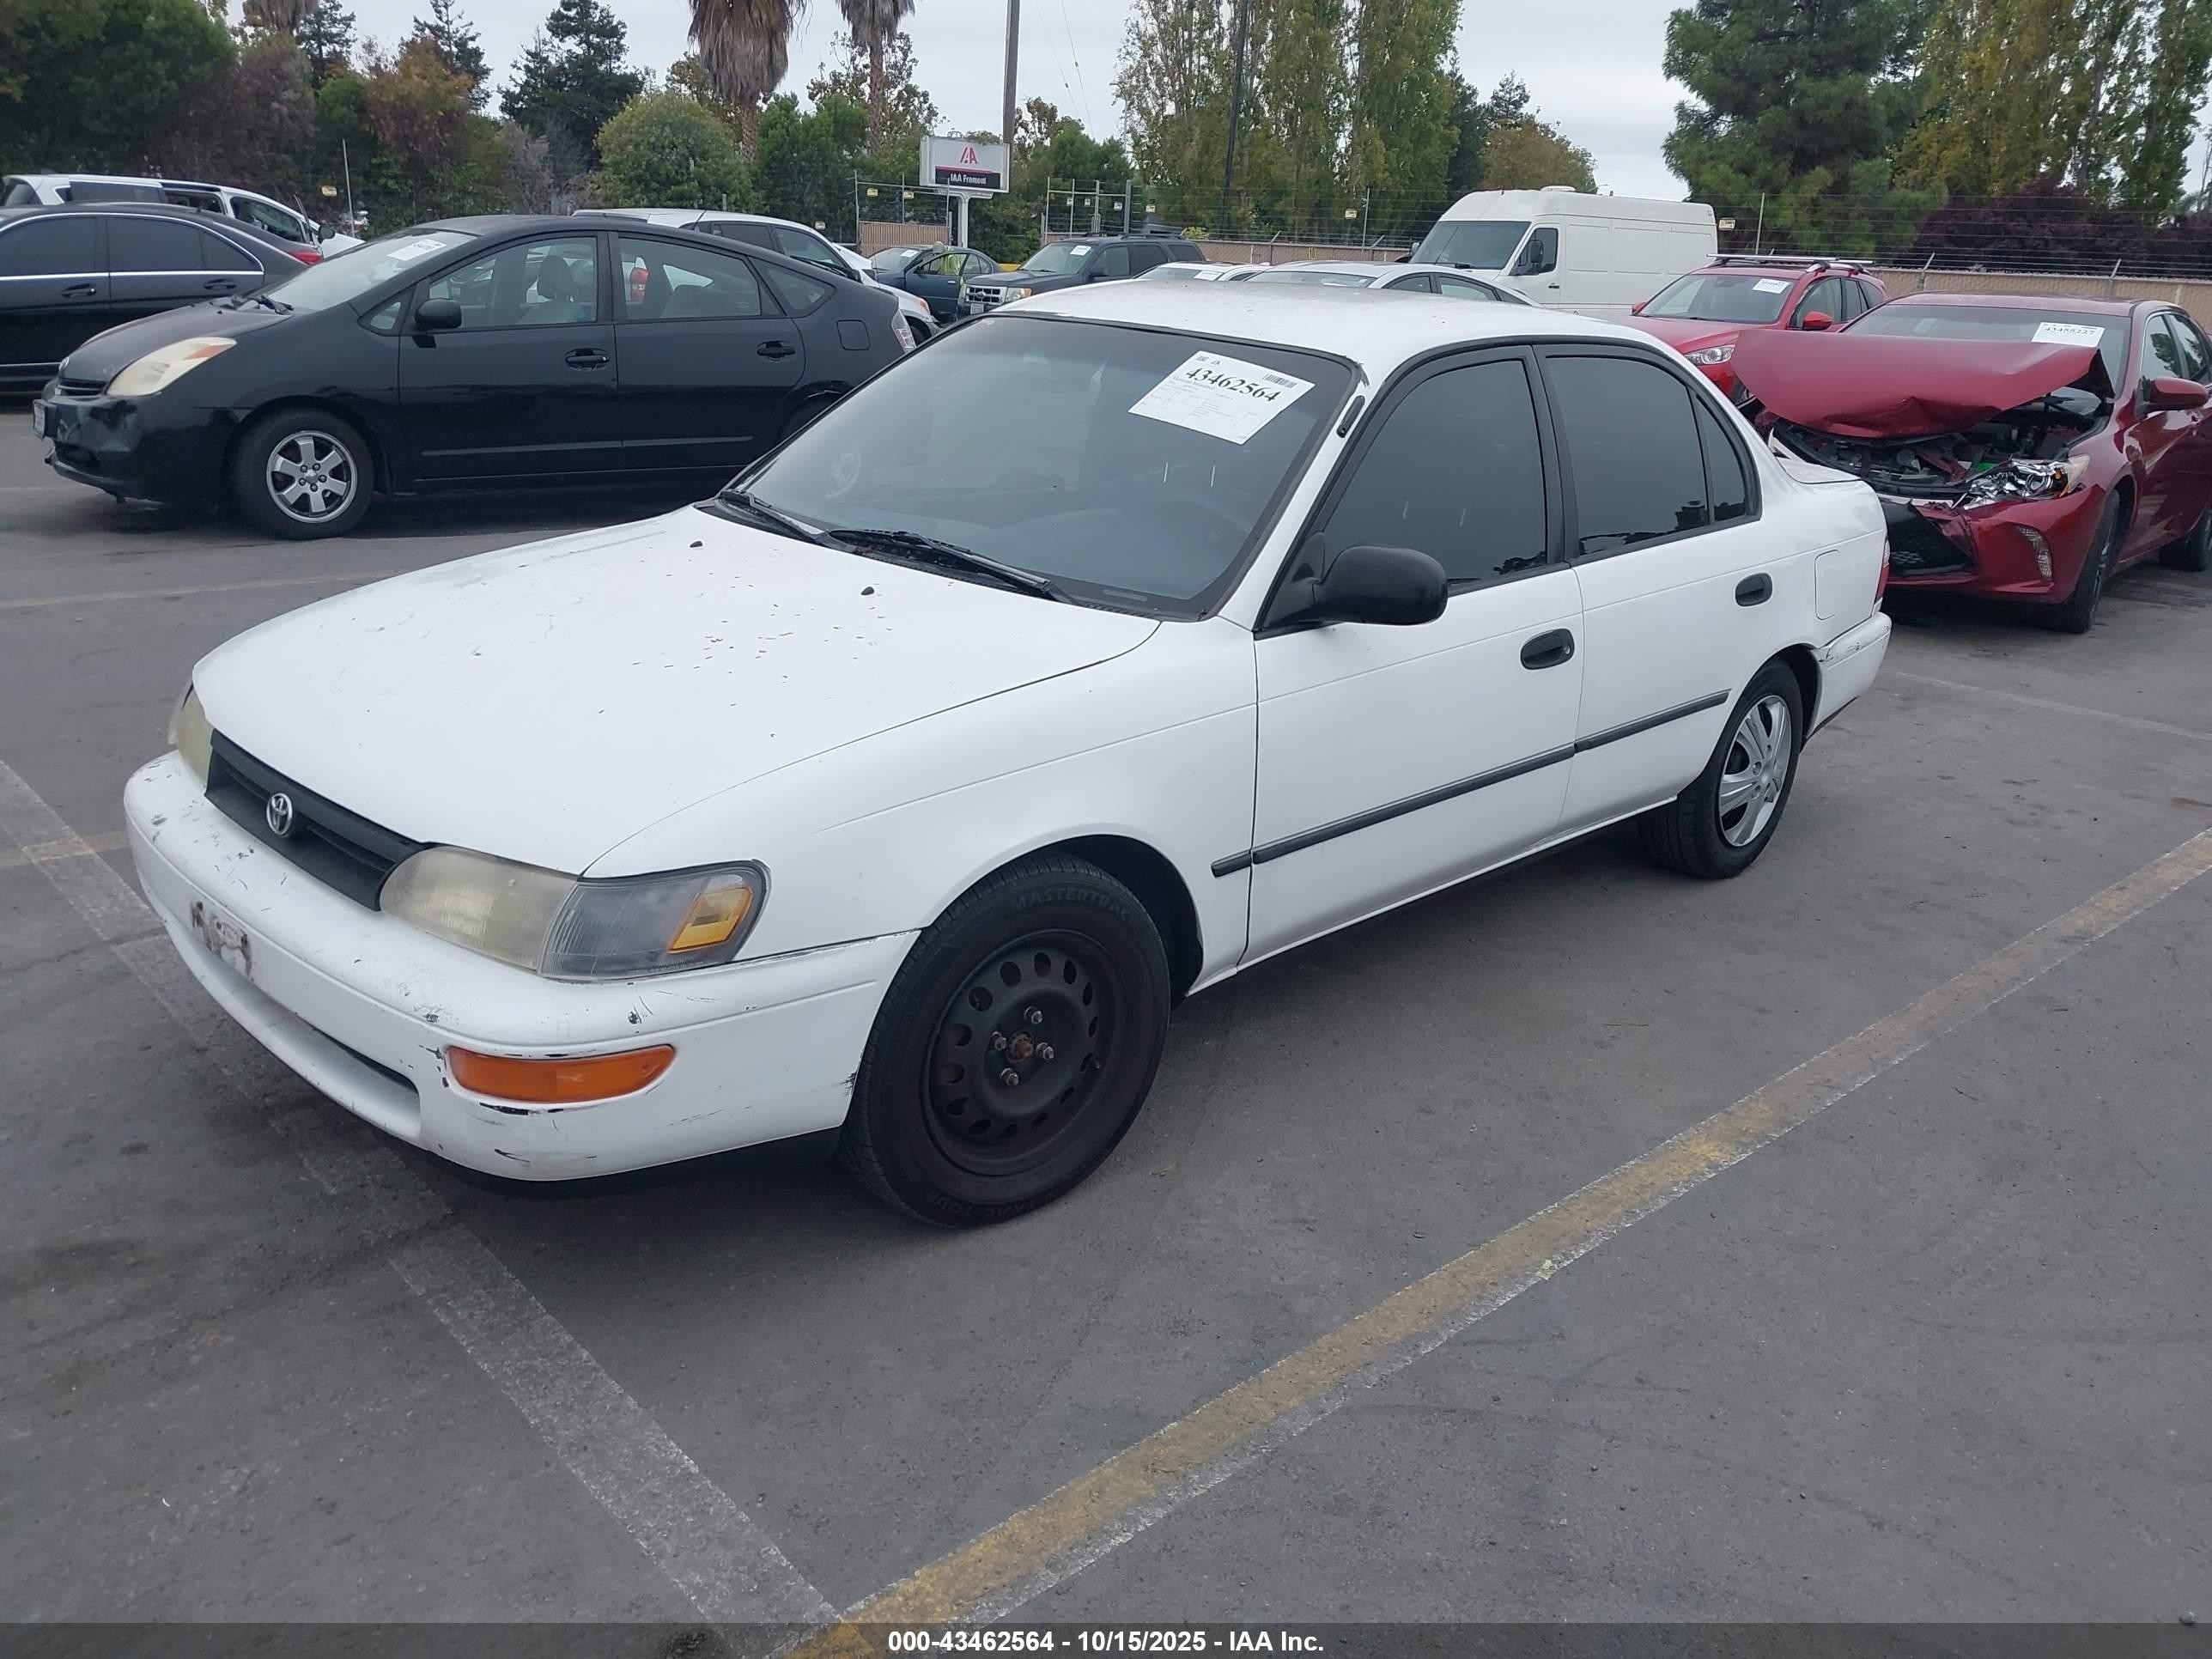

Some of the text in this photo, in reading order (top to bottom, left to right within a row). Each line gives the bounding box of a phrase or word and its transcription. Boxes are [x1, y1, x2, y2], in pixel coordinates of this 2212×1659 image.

[951, 173, 987, 185] IAA Fremont
[1186, 368, 1282, 402] 43462564
